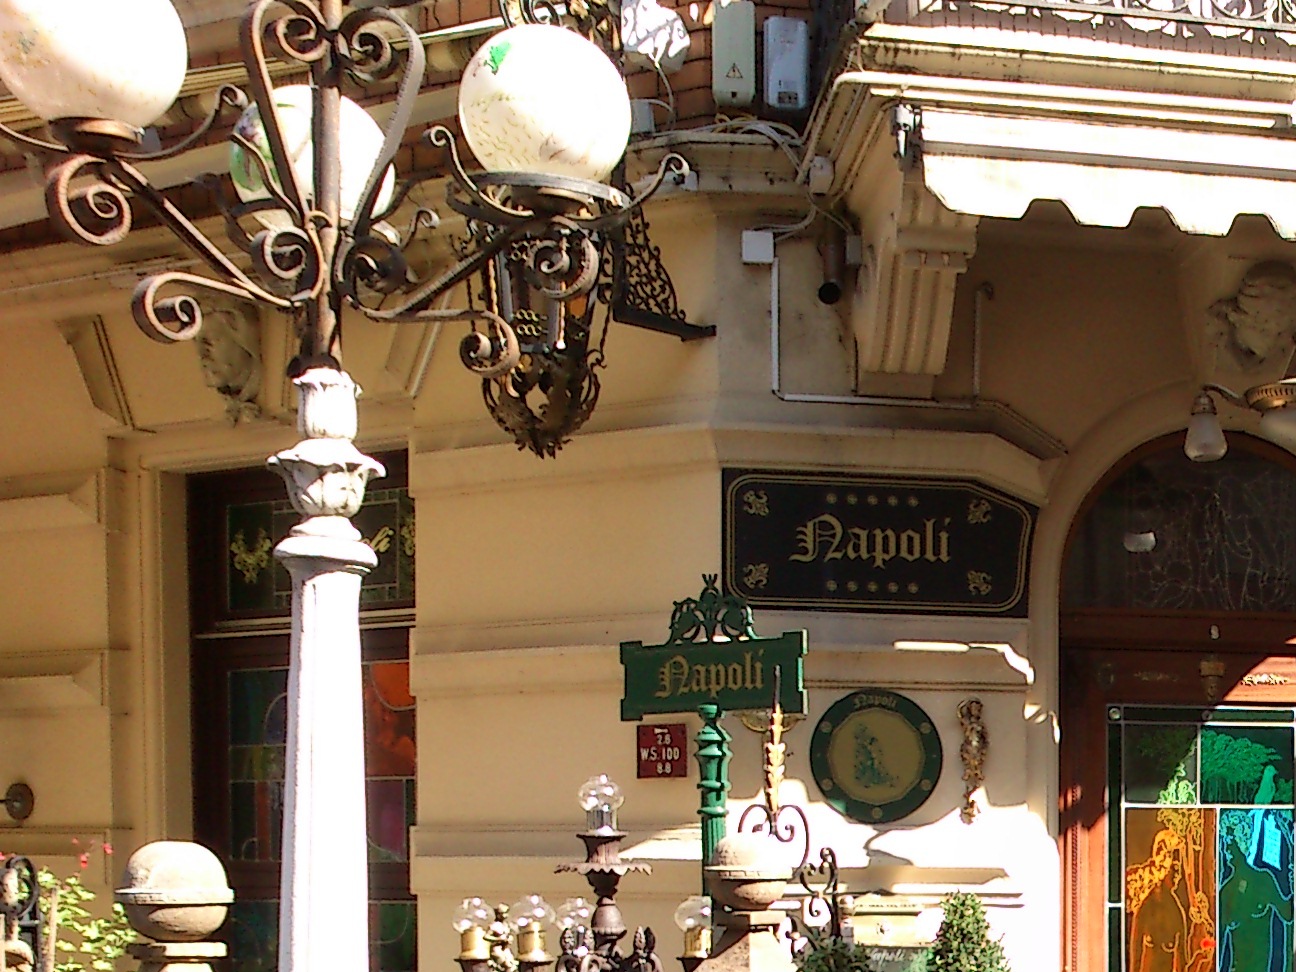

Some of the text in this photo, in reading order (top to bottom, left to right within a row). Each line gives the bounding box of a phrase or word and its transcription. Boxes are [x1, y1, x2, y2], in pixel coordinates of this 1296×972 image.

[788, 514, 951, 569] Napoli
[655, 650, 764, 699] Napoli
[853, 694, 897, 709] Napoli
